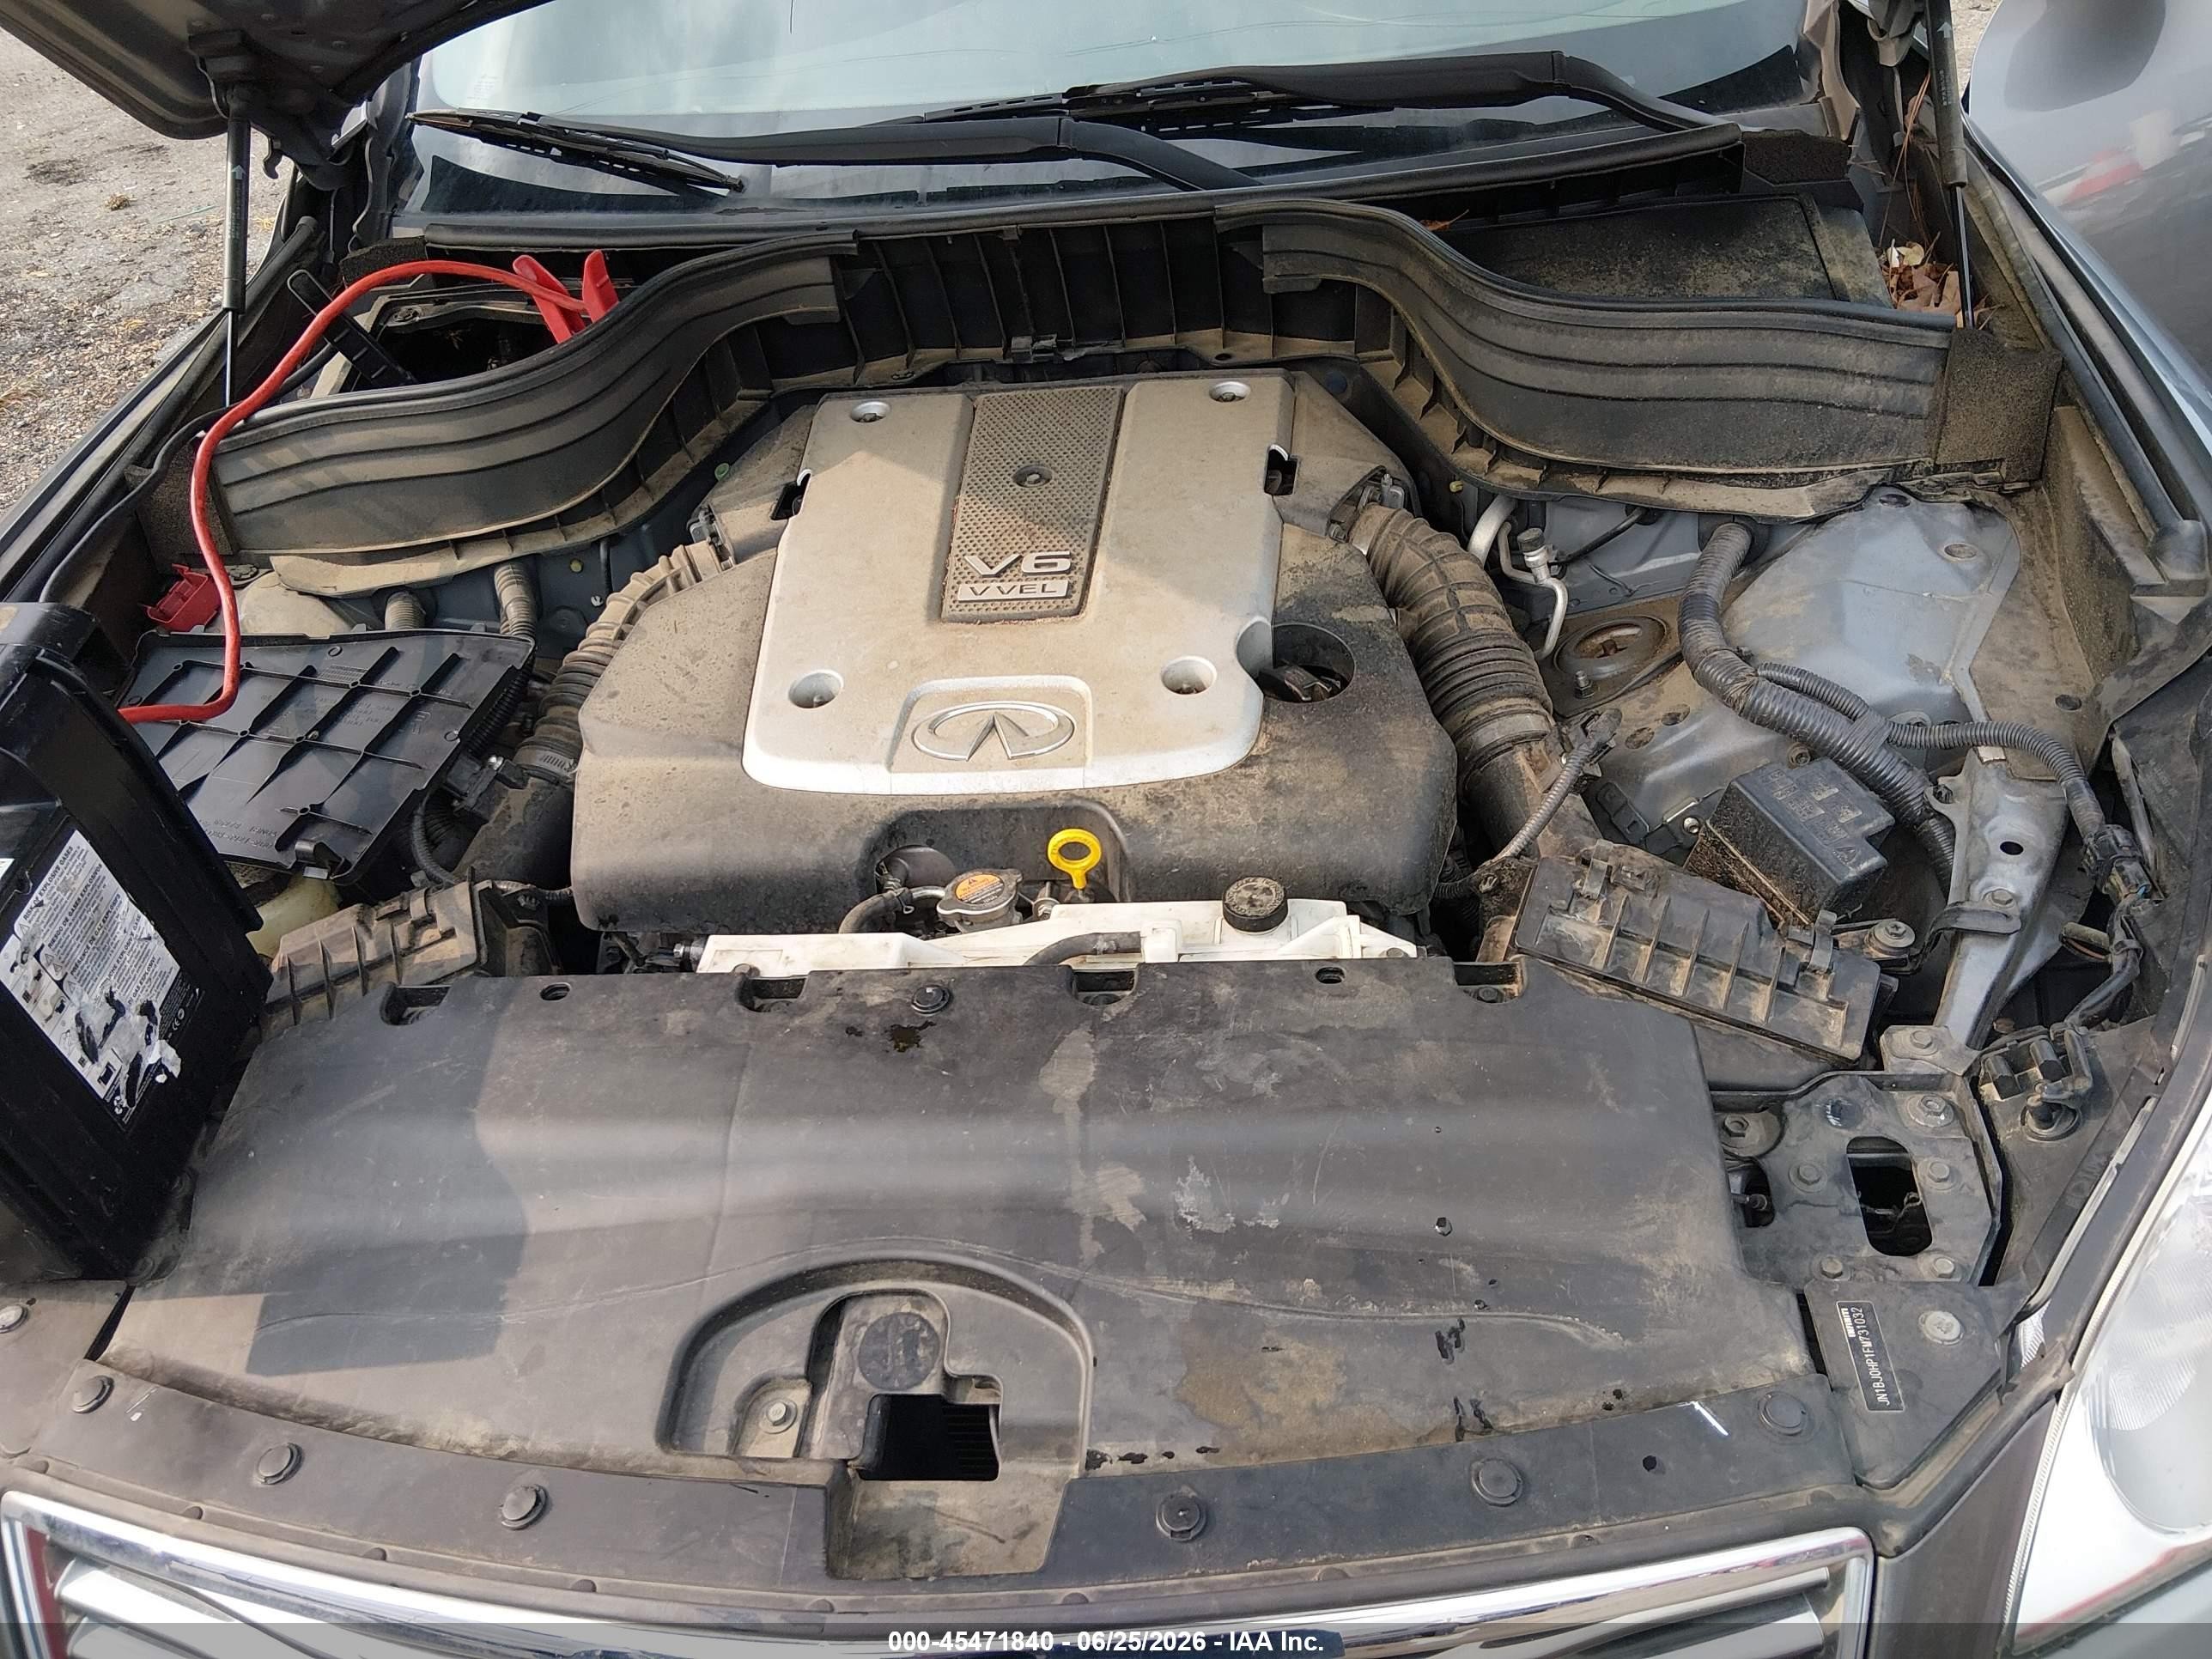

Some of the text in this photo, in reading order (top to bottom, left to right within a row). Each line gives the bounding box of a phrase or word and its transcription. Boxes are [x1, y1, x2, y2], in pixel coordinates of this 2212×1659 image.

[963, 550, 1072, 578] V6
[969, 584, 1057, 597] VVEL
[22, 904, 33, 921] RISK
[38, 863, 61, 896] EXPLOSIVE
[58, 844, 73, 866] GASES
[47, 862, 102, 949] RIESGO DE GASES EXPLOSIVOS
[88, 935, 95, 945] DE
[94, 922, 102, 936] GAZ
[100, 892, 121, 924] EXPLOSIFS
[131, 984, 141, 998] GAS
[1850, 1307, 1890, 1406] JN1BJ0HP1FM731032
